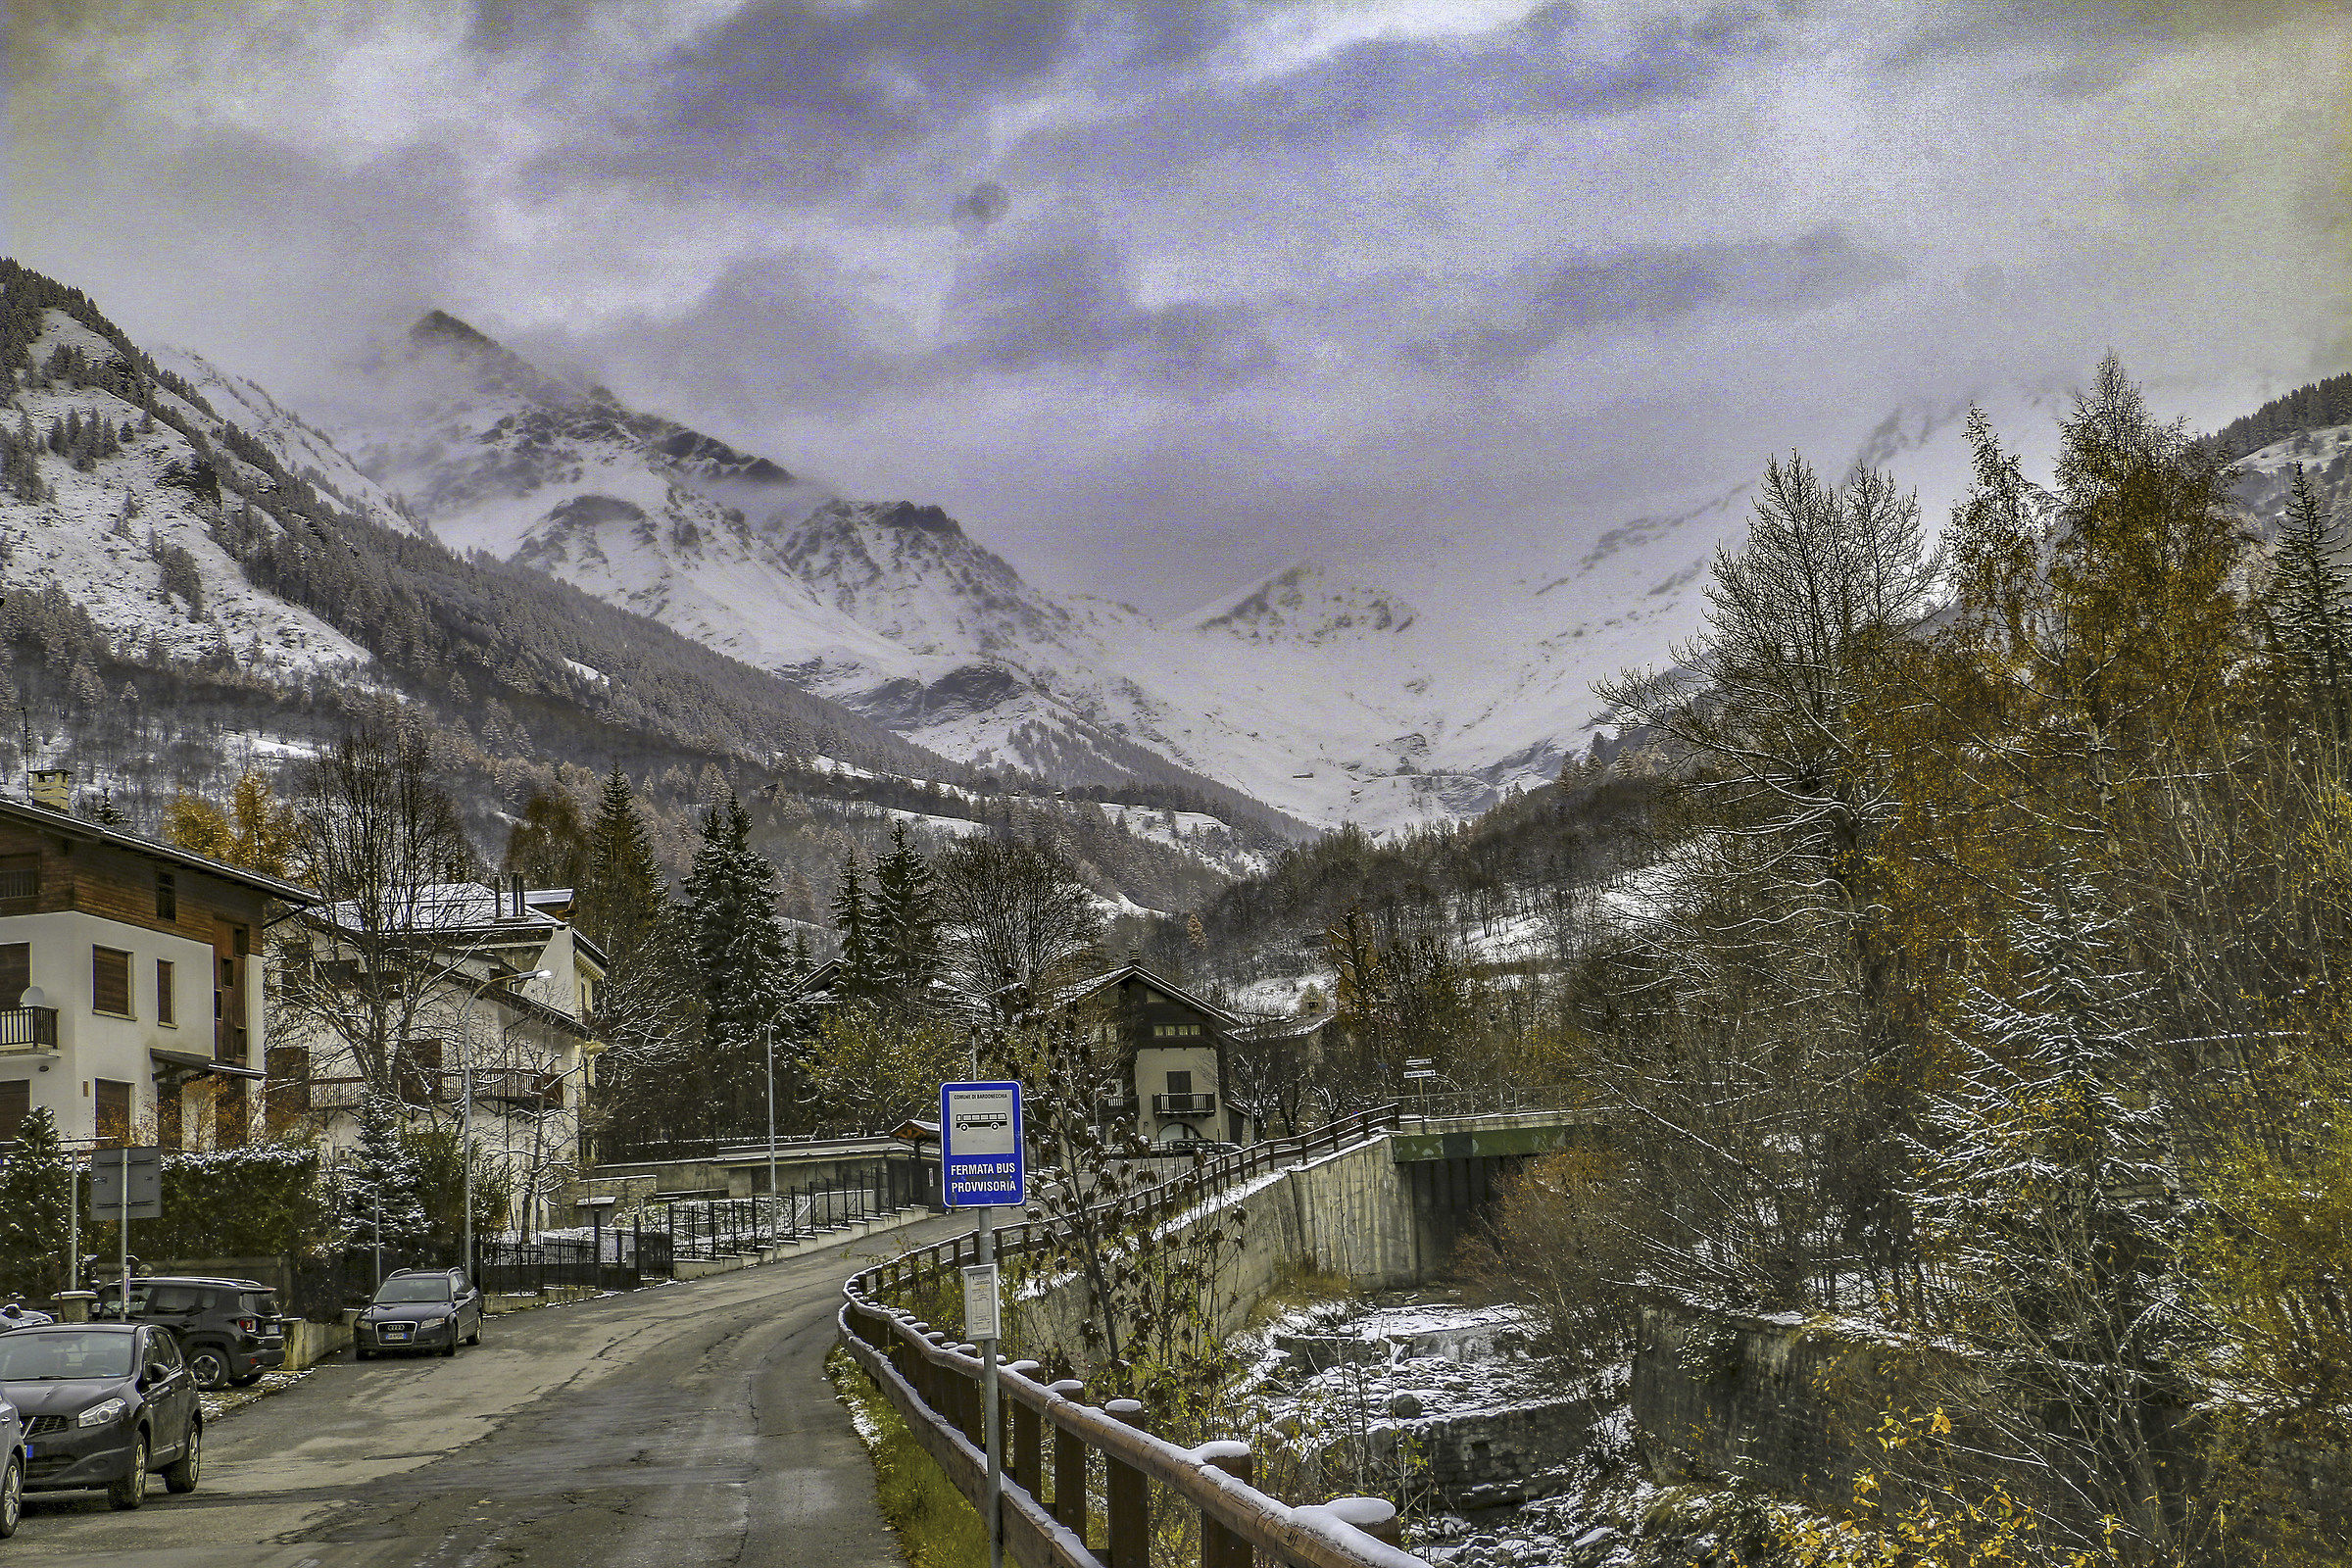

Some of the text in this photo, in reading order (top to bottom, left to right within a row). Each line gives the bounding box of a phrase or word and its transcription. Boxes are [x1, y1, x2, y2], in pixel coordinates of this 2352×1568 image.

[951, 1162, 1015, 1176] FERMATA BUS
[952, 1180, 1016, 1193] PROVVISORIA
